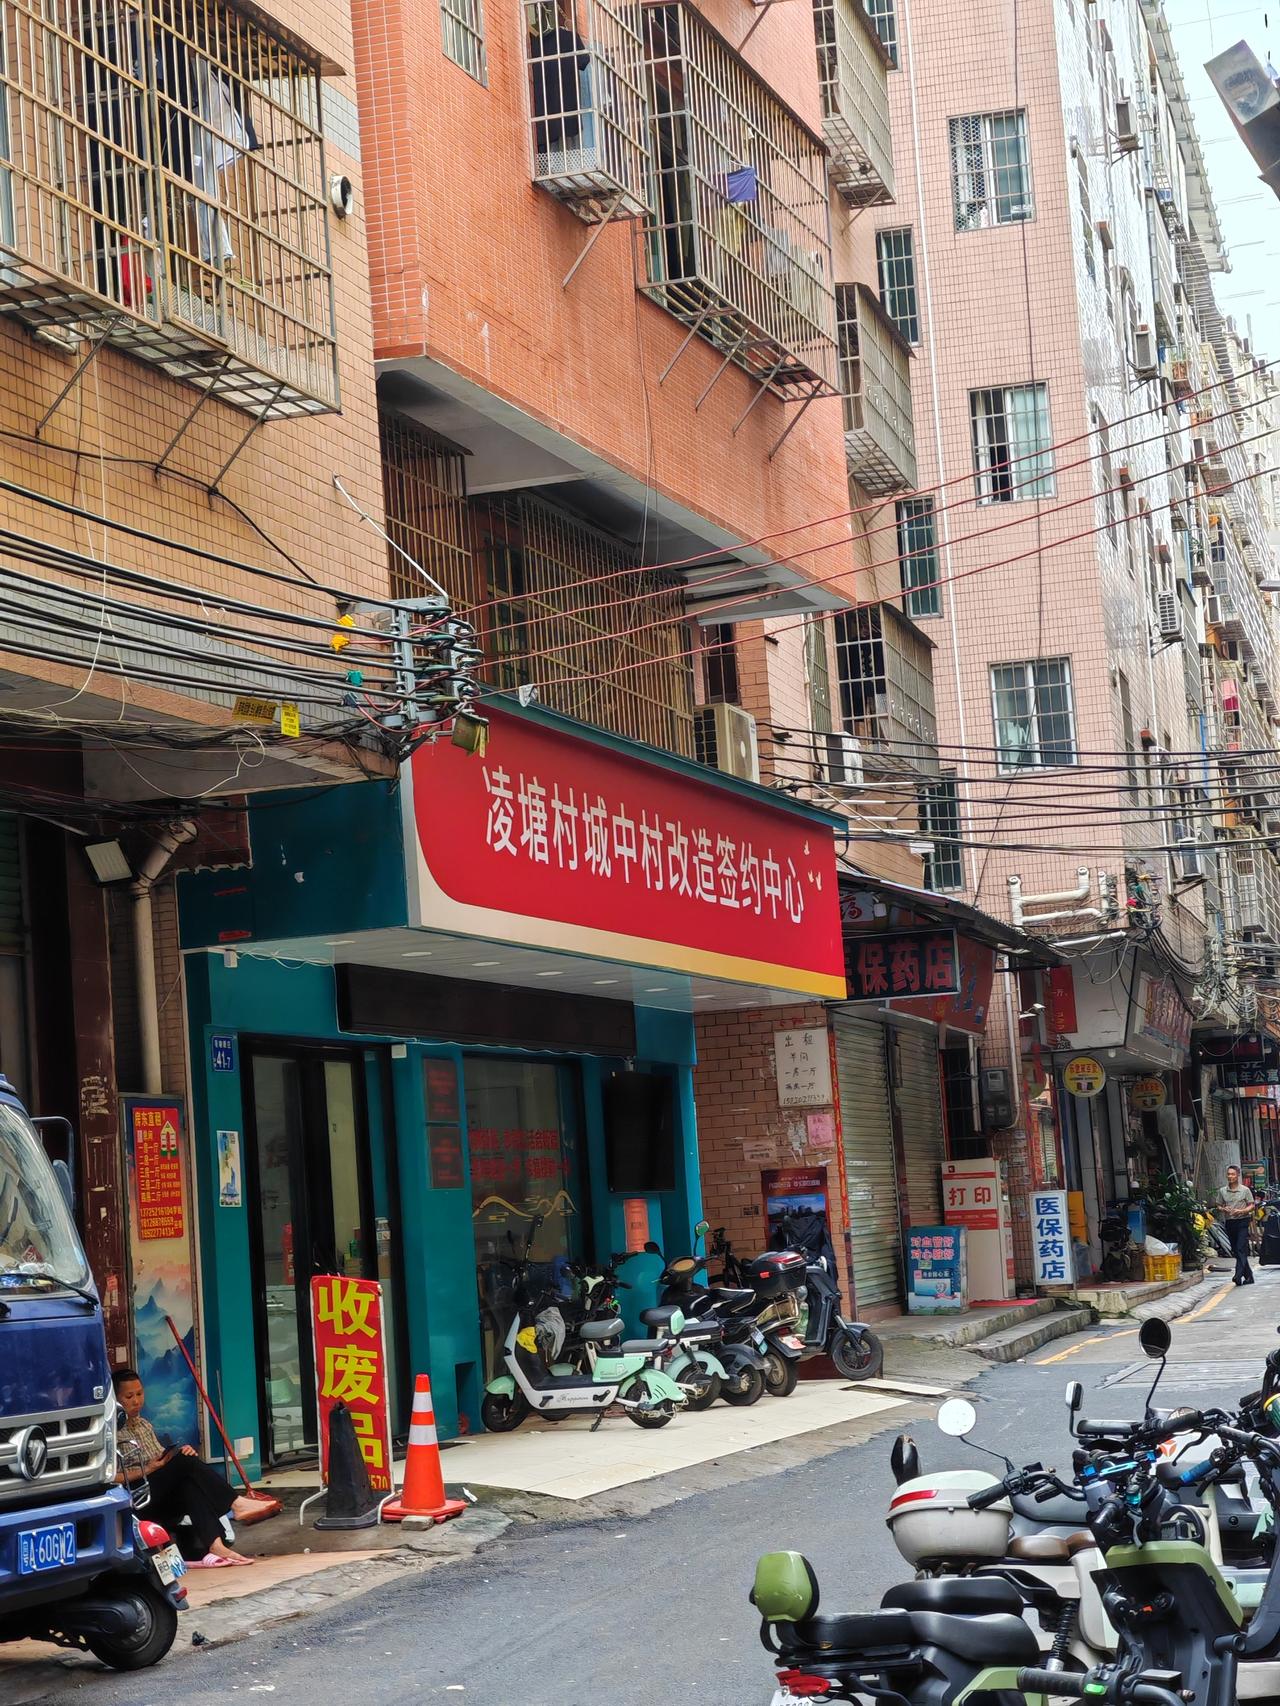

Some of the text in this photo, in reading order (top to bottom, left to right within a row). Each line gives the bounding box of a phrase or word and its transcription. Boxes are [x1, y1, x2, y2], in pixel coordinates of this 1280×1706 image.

[482, 765, 804, 924] 凌塘村城中村改造签约中心
[847, 937, 954, 995] 保药店
[948, 1186, 992, 1206] 打印
[1035, 1196, 1066, 1280] 医保药店
